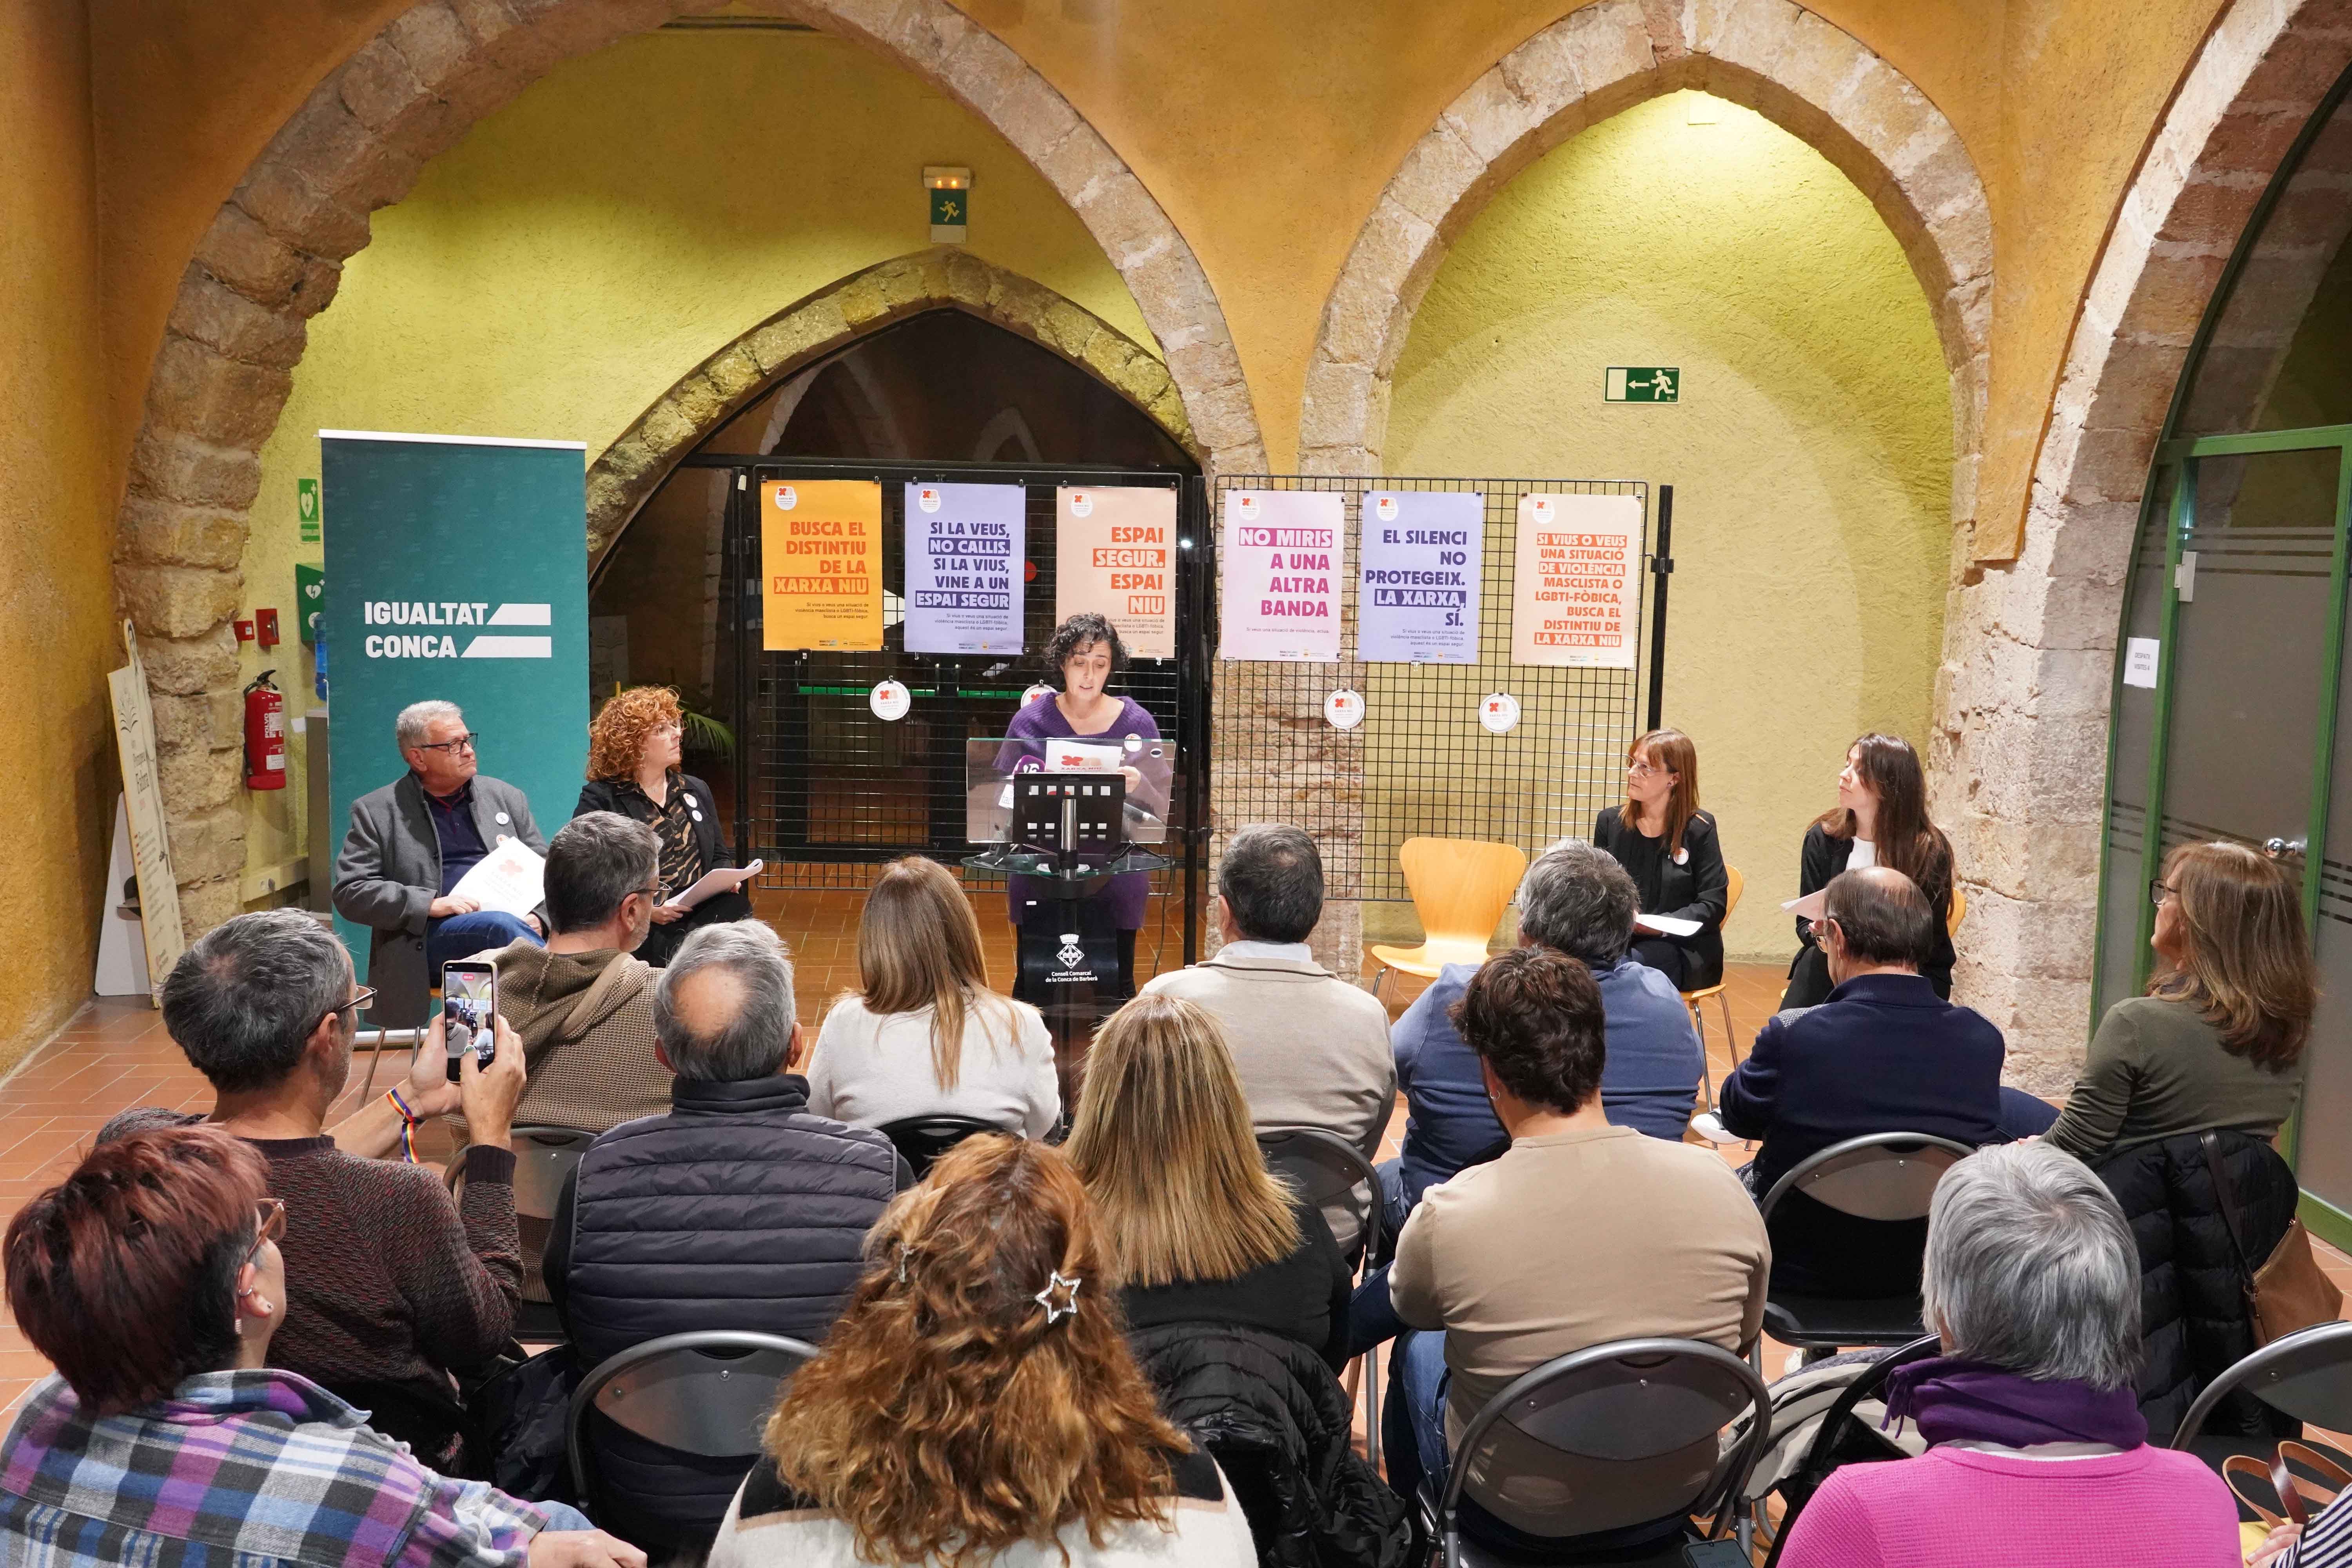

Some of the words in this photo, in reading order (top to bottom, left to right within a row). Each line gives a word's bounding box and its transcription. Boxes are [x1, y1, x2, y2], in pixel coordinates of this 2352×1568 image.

[790, 522, 843, 536] BUSCA
[849, 522, 866, 536] EL
[931, 522, 942, 534] SI
[948, 523, 965, 535] LA
[970, 523, 1010, 538] VEUS,
[1112, 527, 1163, 543] ESPAI
[1240, 529, 1270, 545] NO
[1276, 530, 1332, 548] MIRIS
[1383, 530, 1400, 543] EL
[1406, 530, 1467, 545] SILENCI
[1538, 534, 1548, 545] SI
[1552, 534, 1579, 545] VIUS
[1581, 535, 1592, 546] O
[1595, 535, 1625, 546] VEUS
[786, 541, 866, 555] DISTINTIU
[930, 539, 954, 553] NO
[958, 541, 1010, 554] CALLIS.
[1541, 548, 1565, 559] UNA
[1569, 548, 1624, 560] SITUACIÓ
[1096, 550, 1163, 567] SEGUR.
[1270, 554, 1283, 569] A
[1290, 554, 1330, 570] UNA
[1440, 551, 1466, 565] NO
[820, 560, 841, 573] DE
[847, 560, 866, 573] LA
[934, 558, 946, 570] SI
[951, 559, 968, 570] LA
[973, 559, 1009, 574] VIUS,
[1539, 563, 1555, 573] DE
[775, 578, 833, 592] XARXA
[839, 579, 867, 593] NIU
[935, 576, 969, 588] VINE
[974, 577, 984, 588] A
[989, 577, 1009, 589] UN
[1111, 574, 1163, 590] ESPAI
[1270, 577, 1329, 593] ALTRA
[1366, 570, 1465, 586] PROTEGEIX.
[1544, 577, 1609, 588] MASCLISTA
[1613, 579, 1622, 589] O
[916, 593, 956, 606] ESPAI
[961, 594, 1009, 608] SEGUR
[1130, 597, 1163, 613] NIU
[1377, 590, 1397, 605] LA
[1402, 591, 1465, 609] XARXA,
[1535, 590, 1621, 605] LGBTI-FÒBICA,
[365, 602, 488, 625] IGUALTAT
[1261, 600, 1328, 617] BANDA
[1567, 606, 1604, 617] BUSCA
[1609, 608, 1621, 617] EL
[1445, 608, 1464, 626] SÍ.
[1544, 620, 1601, 631] DISTINTIU
[1605, 622, 1620, 632] DE
[365, 635, 458, 658] CONCA
[1536, 633, 1551, 644] LA
[1554, 634, 1595, 645] XARXA
[1599, 635, 1620, 646] NIU
